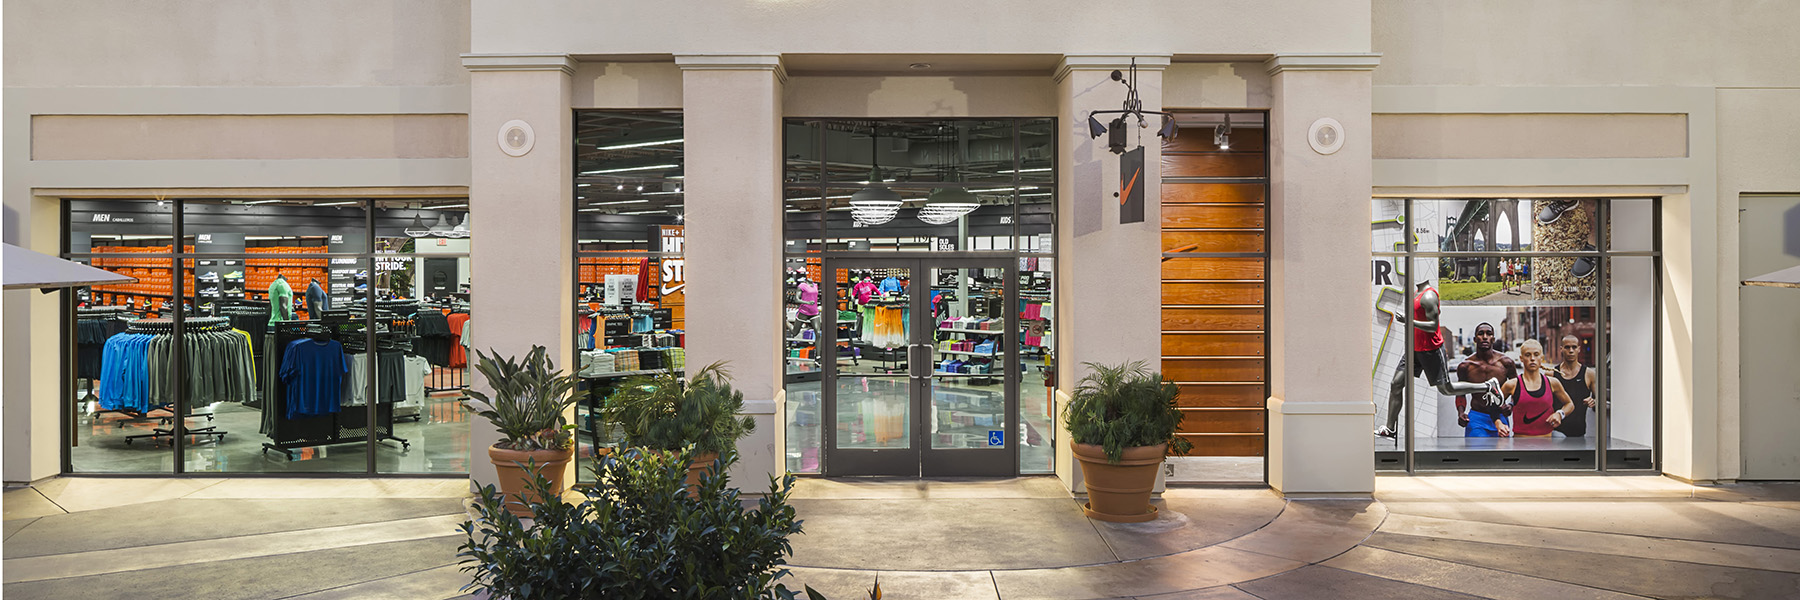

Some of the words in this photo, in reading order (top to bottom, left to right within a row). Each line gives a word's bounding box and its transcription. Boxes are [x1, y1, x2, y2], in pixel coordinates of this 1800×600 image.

[92, 214, 110, 222] MEN
[375, 262, 406, 270] STRIDE.
[1371, 260, 1392, 286] R
